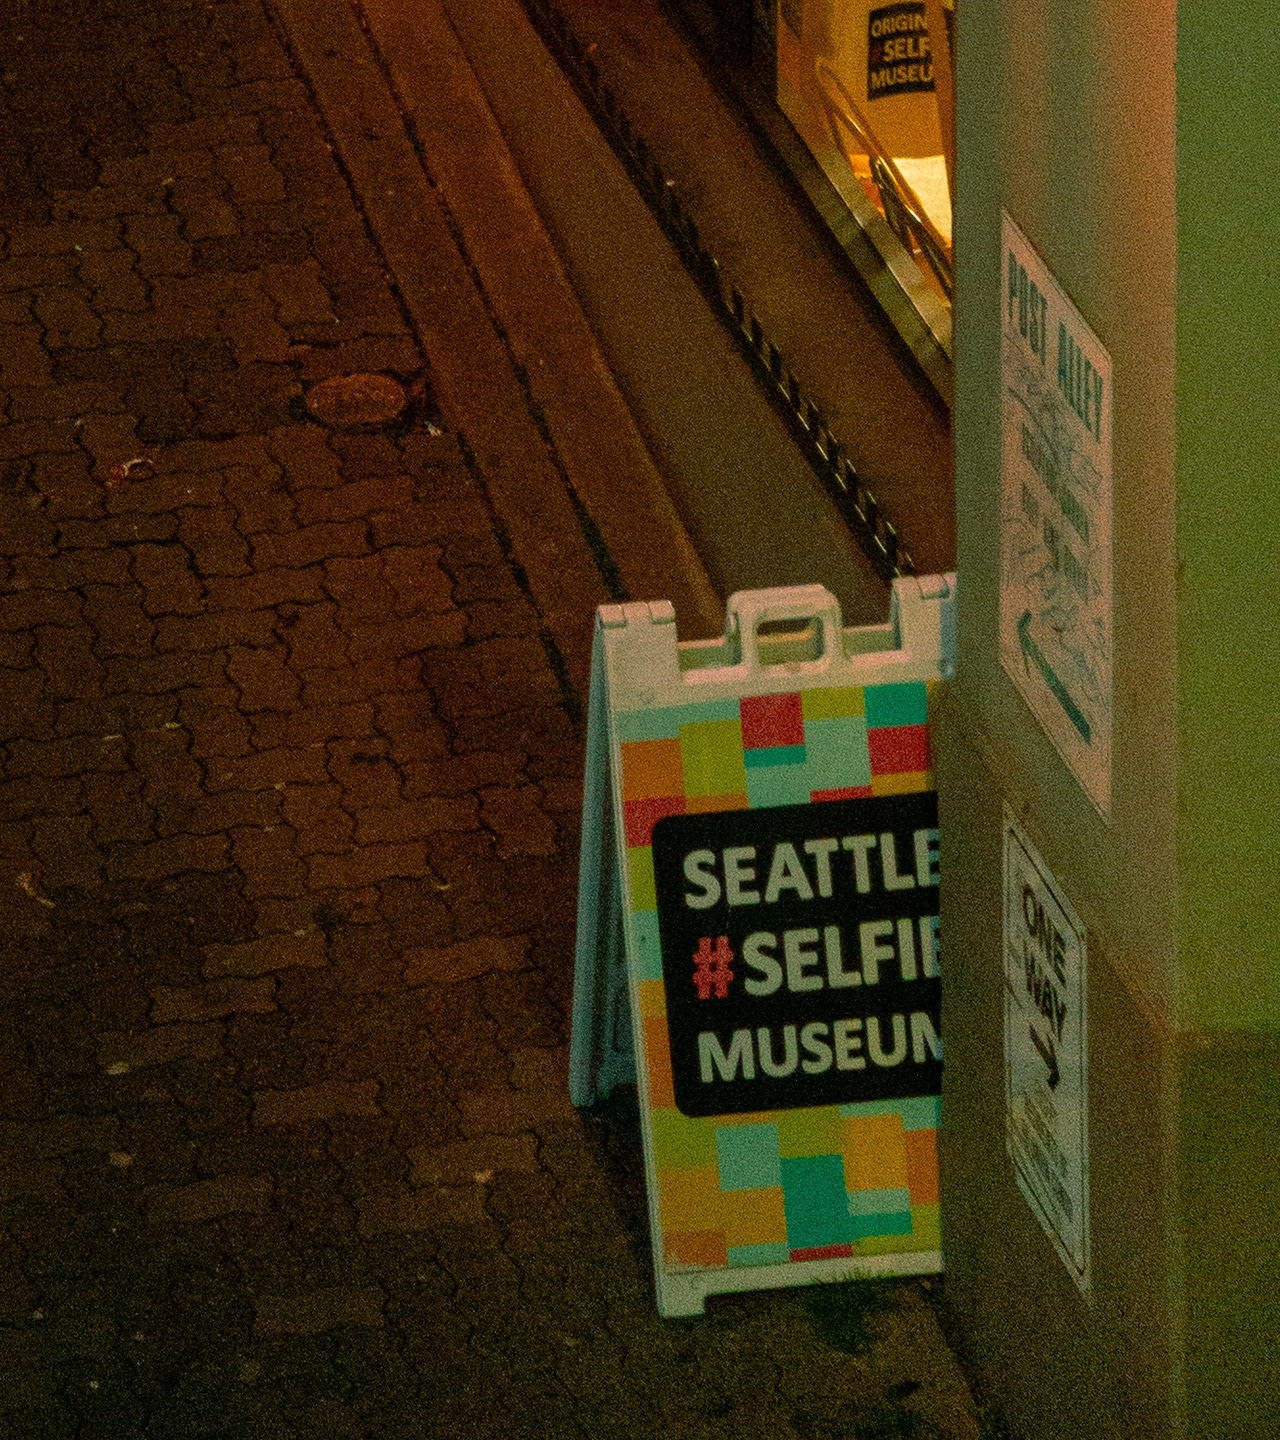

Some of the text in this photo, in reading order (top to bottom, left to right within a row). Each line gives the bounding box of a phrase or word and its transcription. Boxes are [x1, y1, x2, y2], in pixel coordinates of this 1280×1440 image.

[1008, 248, 1104, 444] POST ALLEY
[684, 829, 941, 909] SEATTLE
[692, 915, 942, 999] #SELFIE
